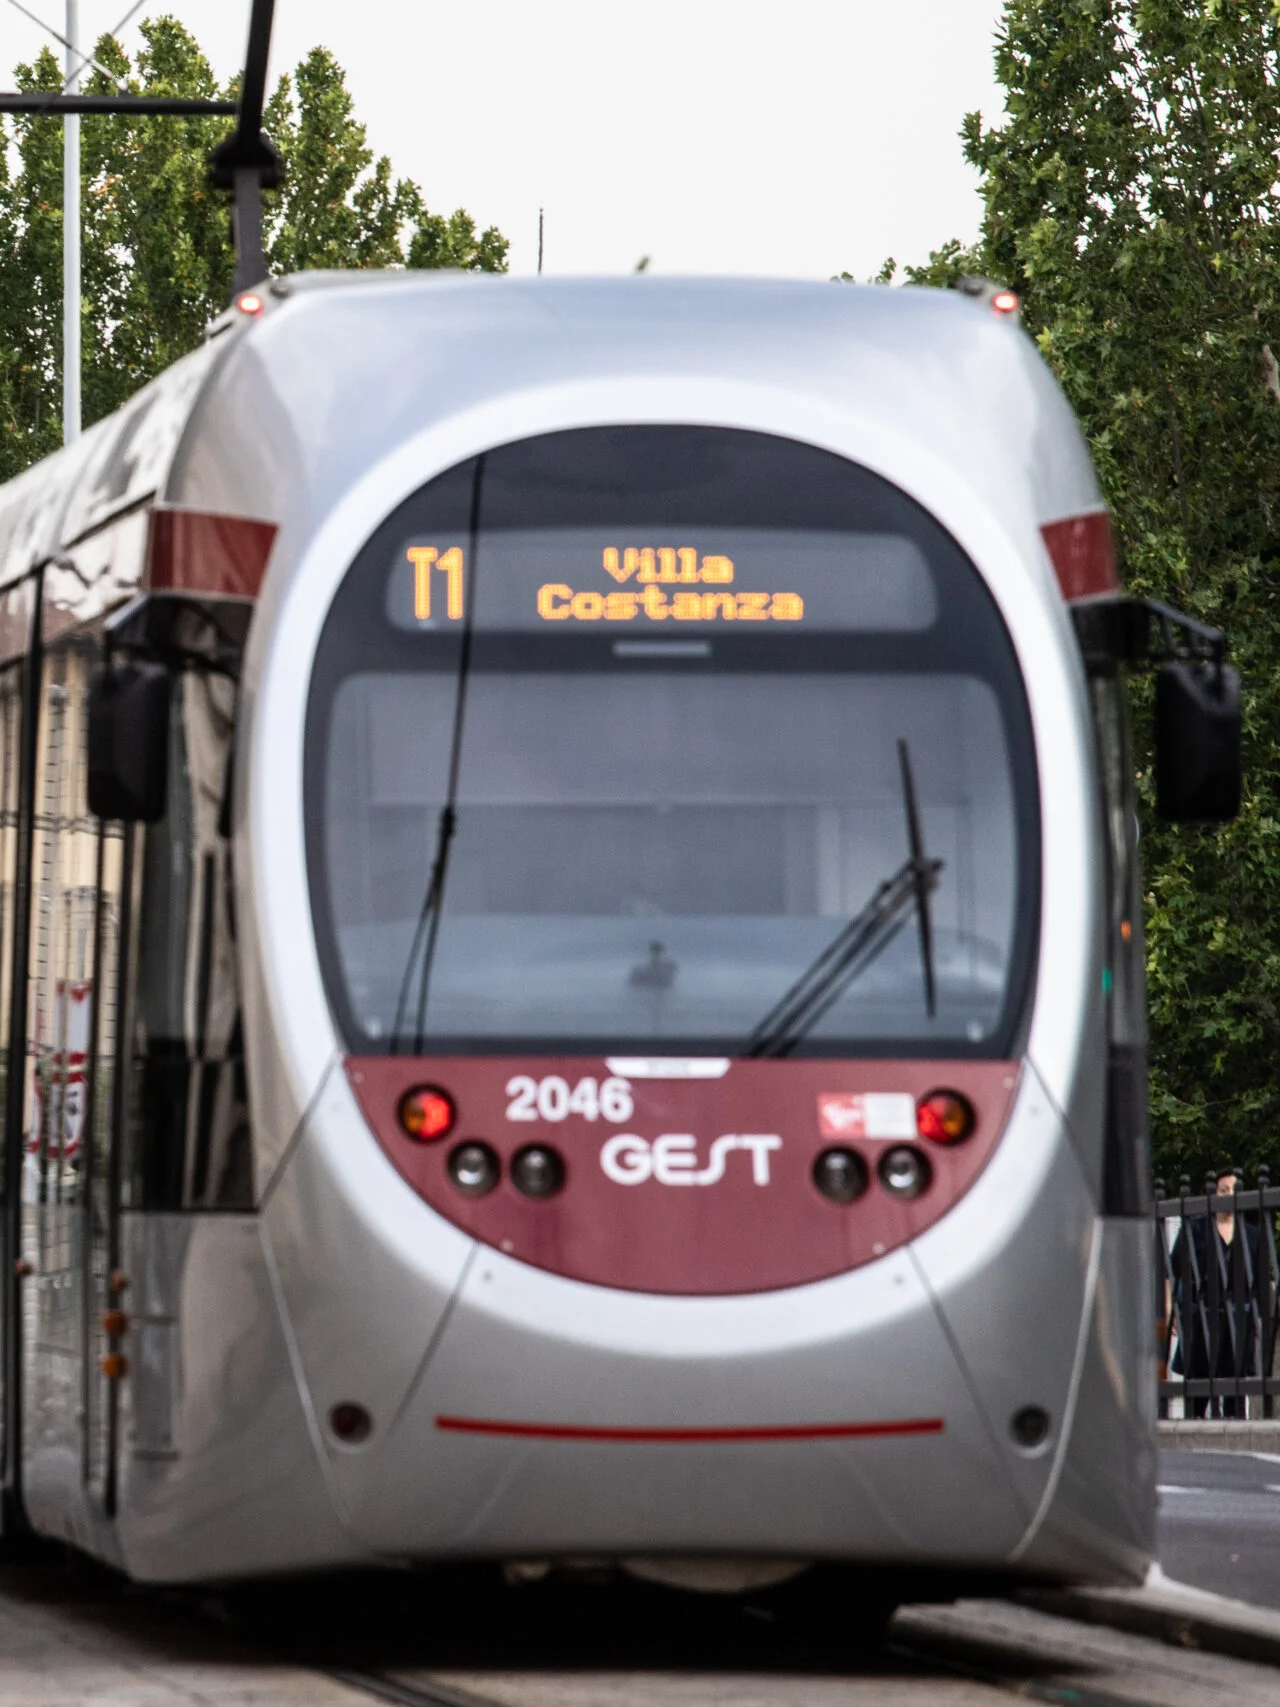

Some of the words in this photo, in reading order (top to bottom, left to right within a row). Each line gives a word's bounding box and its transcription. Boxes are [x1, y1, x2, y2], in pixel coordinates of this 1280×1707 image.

[407, 546, 464, 620] T1
[603, 547, 734, 583] Villa
[537, 584, 804, 621] Costanza
[506, 1075, 634, 1123] 2046
[600, 1134, 783, 1186] GEST
